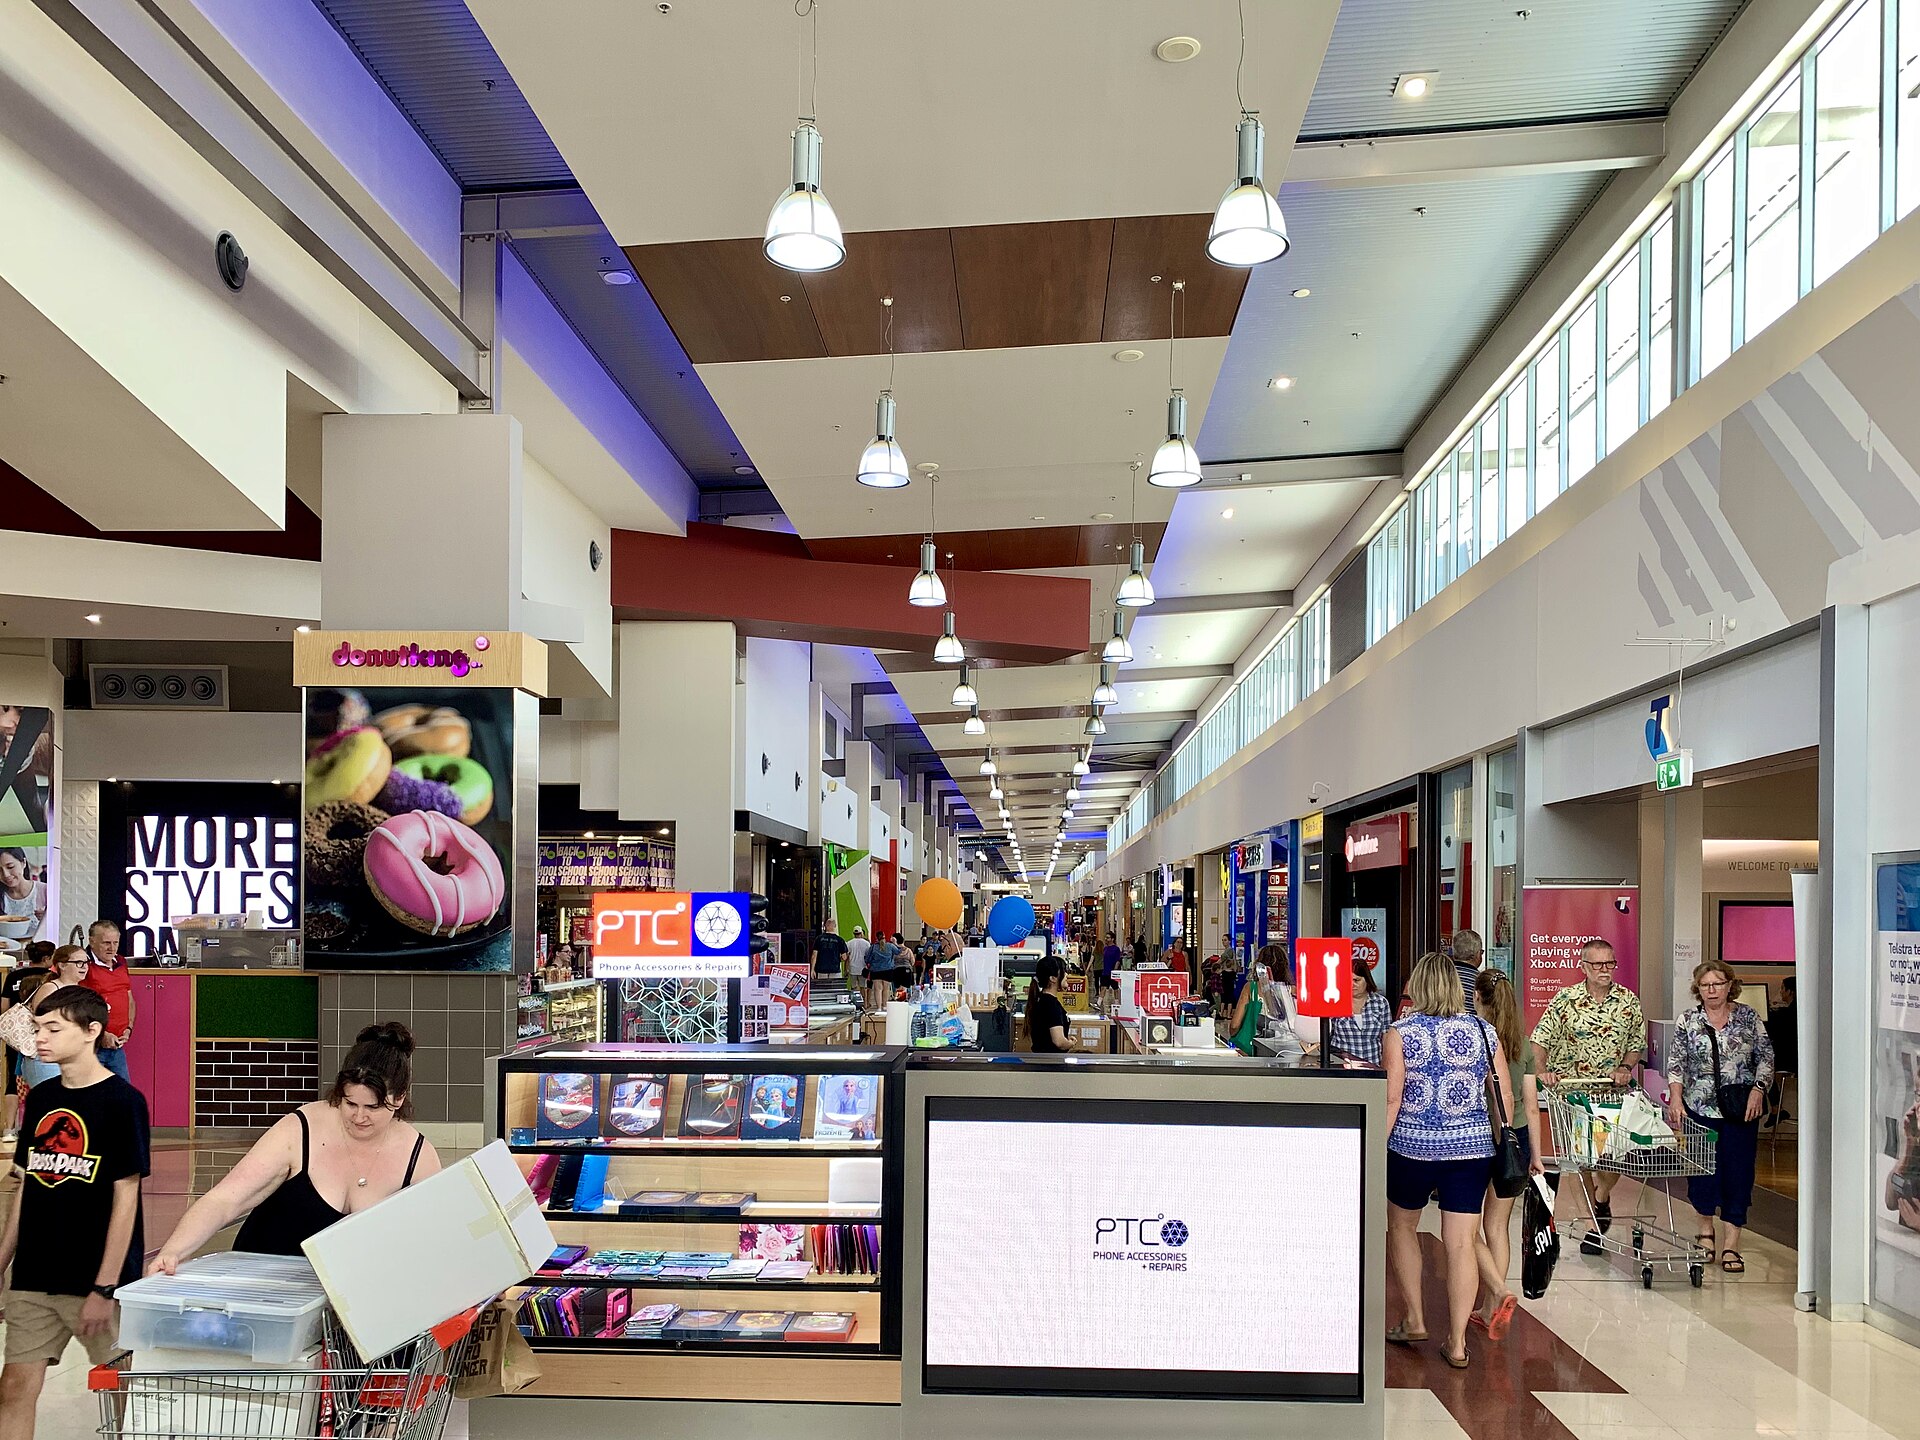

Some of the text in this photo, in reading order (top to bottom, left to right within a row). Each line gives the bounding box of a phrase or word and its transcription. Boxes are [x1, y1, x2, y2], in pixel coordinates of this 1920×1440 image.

[332, 641, 470, 677] donutking
[127, 816, 293, 869] MORE
[558, 846, 580, 856] BACK
[589, 846, 610, 856] BACK
[619, 846, 641, 857] BACK
[562, 856, 573, 866] TO
[592, 857, 603, 866] TO
[622, 857, 633, 866] TO
[557, 866, 587, 877] SCHOOL
[588, 866, 618, 877] SCHOOL
[619, 866, 648, 877] SCHOOL
[1728, 862, 1775, 871] WELCOME
[1778, 862, 1790, 871] TO
[537, 876, 555, 886] EALS
[560, 876, 586, 886] DEALS
[591, 876, 616, 886] DEALS
[621, 876, 646, 886] DEALS
[126, 870, 293, 924] STYLES
[596, 909, 679, 945] PTC
[1530, 934, 1549, 943] Get
[1352, 947, 1377, 960] 20%
[1530, 946, 1571, 959] playing
[1888, 943, 1912, 955] Telstra
[599, 963, 742, 972] Phone Accessories & Repairs
[1530, 959, 1557, 969] Xbox
[1559, 959, 1574, 969] All
[1890, 960, 1897, 968] or
[772, 968, 792, 979] FREE
[1890, 971, 1905, 986] help
[763, 1076, 793, 1084] FROZEN
[54, 1153, 95, 1177] PARK
[1096, 1218, 1160, 1245] PTC
[1093, 1251, 1187, 1261] PHONE ACCESSORIES
[1149, 1263, 1187, 1271] REPAIRS
